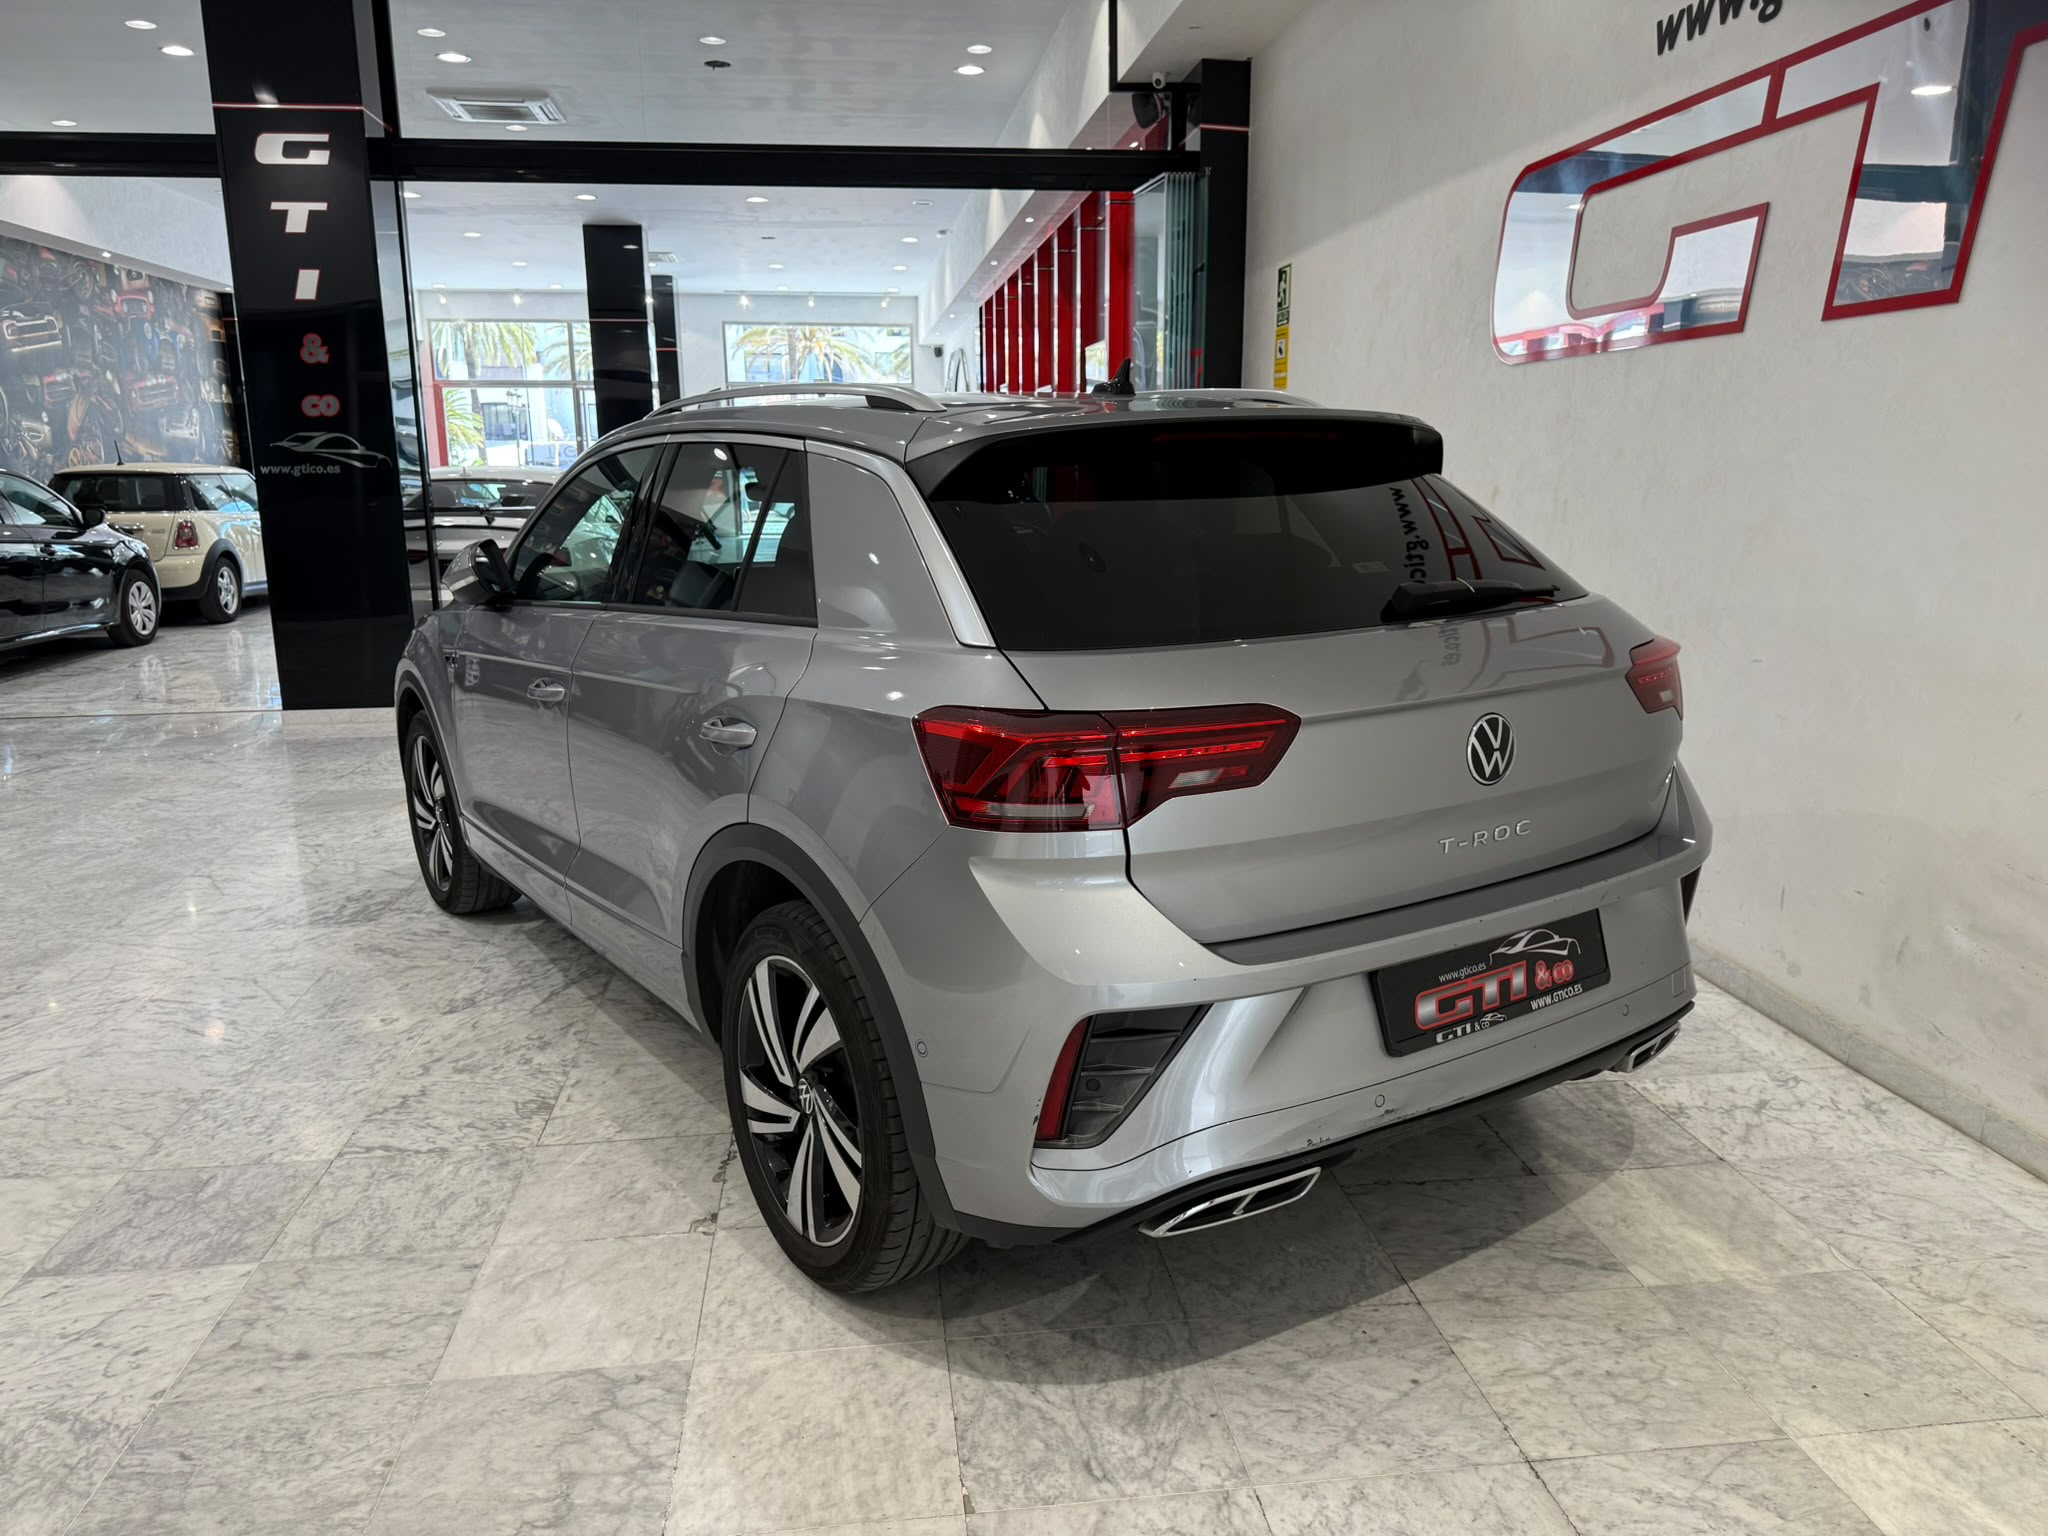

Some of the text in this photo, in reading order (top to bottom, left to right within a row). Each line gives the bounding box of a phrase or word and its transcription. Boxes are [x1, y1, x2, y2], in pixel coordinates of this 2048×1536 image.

[261, 463, 341, 477] www.gtico.es
[1438, 819, 1531, 855] T-ROC
[1438, 961, 1487, 983] www.gtico.es
[1414, 960, 1528, 1030] GTI
[1530, 983, 1583, 1011] WWW.GTICO.ES
